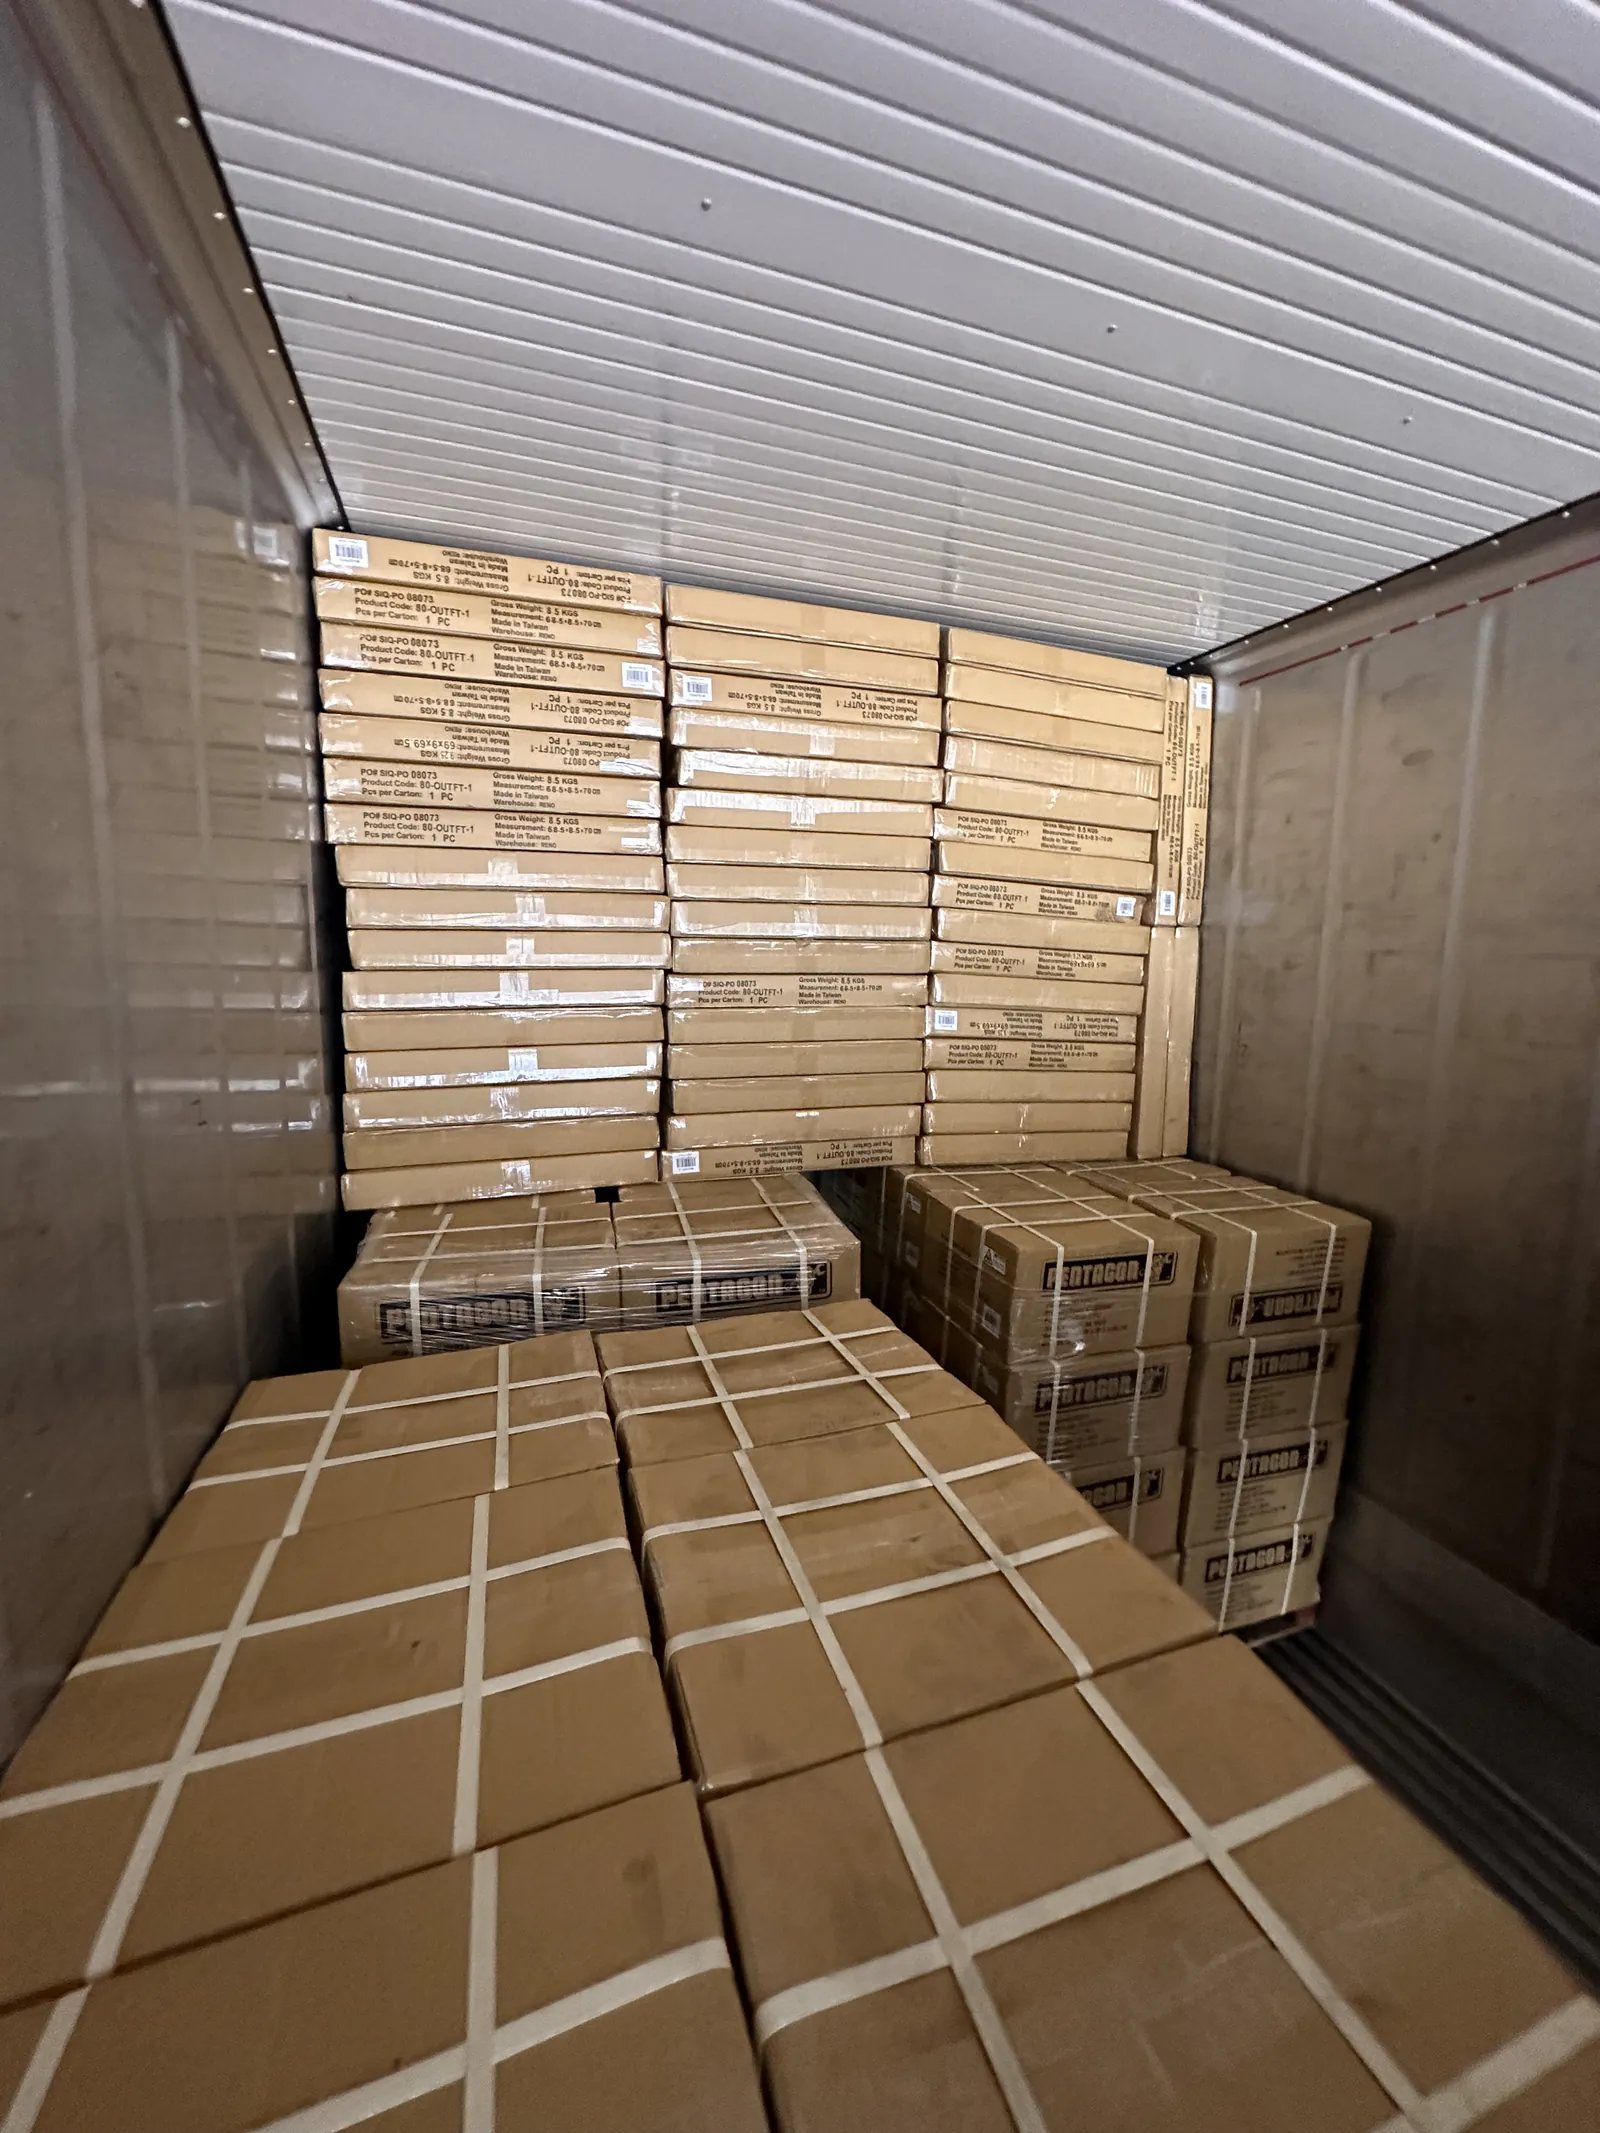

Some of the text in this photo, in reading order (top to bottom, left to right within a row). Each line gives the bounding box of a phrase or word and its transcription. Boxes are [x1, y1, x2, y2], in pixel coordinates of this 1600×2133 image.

[546, 564, 558, 574] PC
[355, 596, 469, 618] Product Code: 80-OUTFT-1
[490, 599, 512, 608] Gross
[561, 609, 578, 617] KGS
[355, 607, 371, 615] Pcs
[373, 610, 387, 618] per
[388, 611, 417, 621] Carton:
[437, 616, 450, 626] PC
[491, 617, 511, 626] Made
[522, 621, 548, 630] Taiwan
[360, 643, 392, 653] Product
[394, 647, 416, 656] Code:
[493, 643, 515, 652] Gross
[518, 646, 545, 656] Weight:
[567, 652, 584, 660] KGS
[378, 656, 391, 664] per
[393, 656, 422, 666] Carton:
[442, 662, 454, 671] PC
[494, 662, 514, 671] Made
[525, 665, 550, 674] Taiwan
[451, 691, 478, 700] Taiwan
[489, 694, 509, 702] Made
[548, 694, 560, 702] PC
[851, 691, 860, 699] PC
[578, 698, 602, 706] Carton:
[419, 706, 437, 714] KGS
[456, 709, 485, 719] Weight:
[531, 702, 630, 717] Product Code: 80-OUTFT-1
[487, 713, 510, 722] Gross
[451, 734, 478, 742] Taiwan
[489, 737, 509, 745] Made
[548, 736, 560, 744] PC
[577, 740, 602, 748] Carton:
[530, 743, 630, 758] Product Code: 80-OUTFT-1
[456, 752, 485, 762] Weight:
[487, 756, 510, 764] Gross
[410, 770, 437, 779] 08073
[517, 774, 544, 783] Weight:
[361, 777, 471, 792] Product Code: 80-OUTFT-1
[361, 787, 377, 795] Pcs
[393, 789, 422, 797] Carton:
[441, 792, 453, 800] PC
[363, 811, 380, 819] PO#
[413, 813, 439, 822] 08073
[518, 815, 545, 823] Weight:
[422, 823, 473, 833] 80-OUTFT-1
[396, 831, 424, 839] Carton:
[443, 834, 455, 842] PC
[1038, 1375, 1131, 1409] PNTAGON
